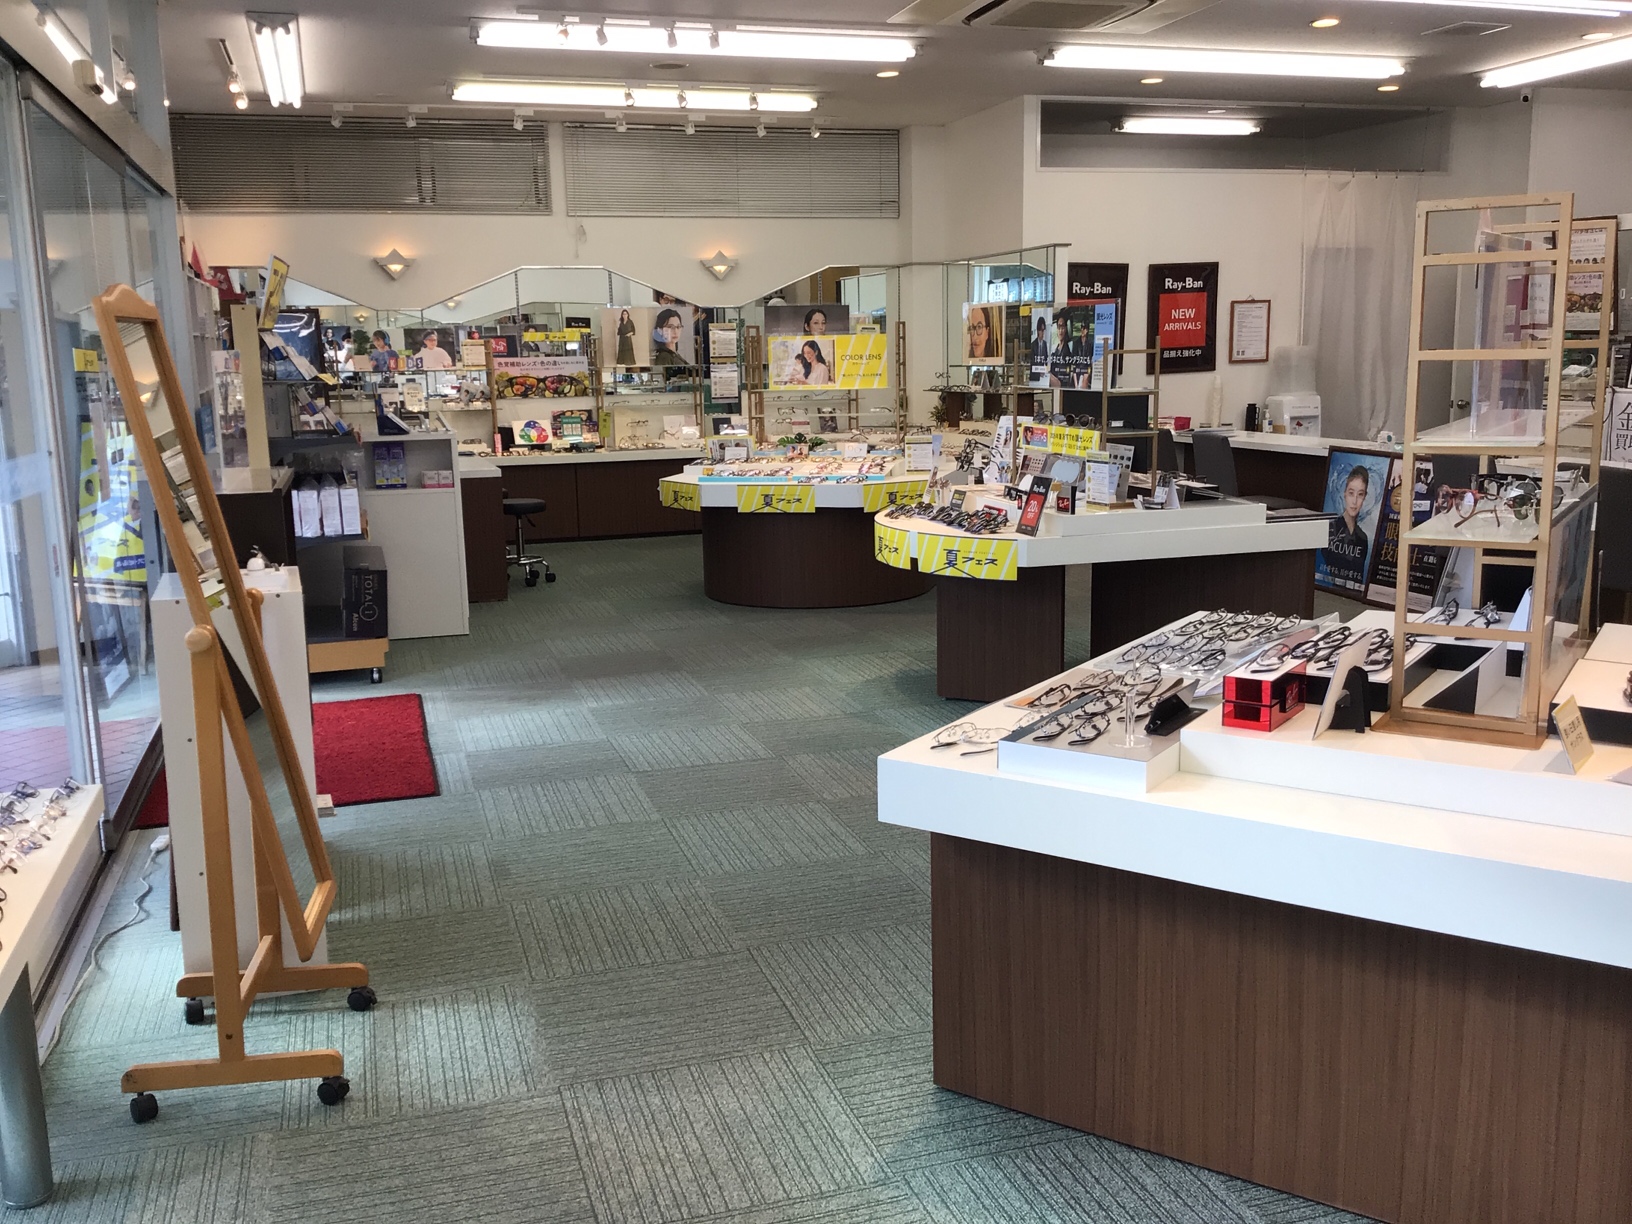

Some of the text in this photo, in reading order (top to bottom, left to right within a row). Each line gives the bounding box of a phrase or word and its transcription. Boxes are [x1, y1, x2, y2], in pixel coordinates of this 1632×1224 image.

[1072, 282, 1112, 296] Ray-Ban
[1165, 277, 1204, 291] Ray-Ban
[1171, 308, 1196, 320] NEW
[1163, 321, 1202, 331] ARRIVALS
[865, 353, 882, 361] LENS
[1162, 349, 1202, 358] 品揃え強化中
[389, 358, 422, 369] KIDS
[761, 493, 803, 506] 夏フェス
[886, 491, 924, 504] 夏フェス
[1328, 541, 1362, 557] ACUVUE
[943, 548, 998, 567] 夏フェス
[364, 574, 374, 607] TOTAL
